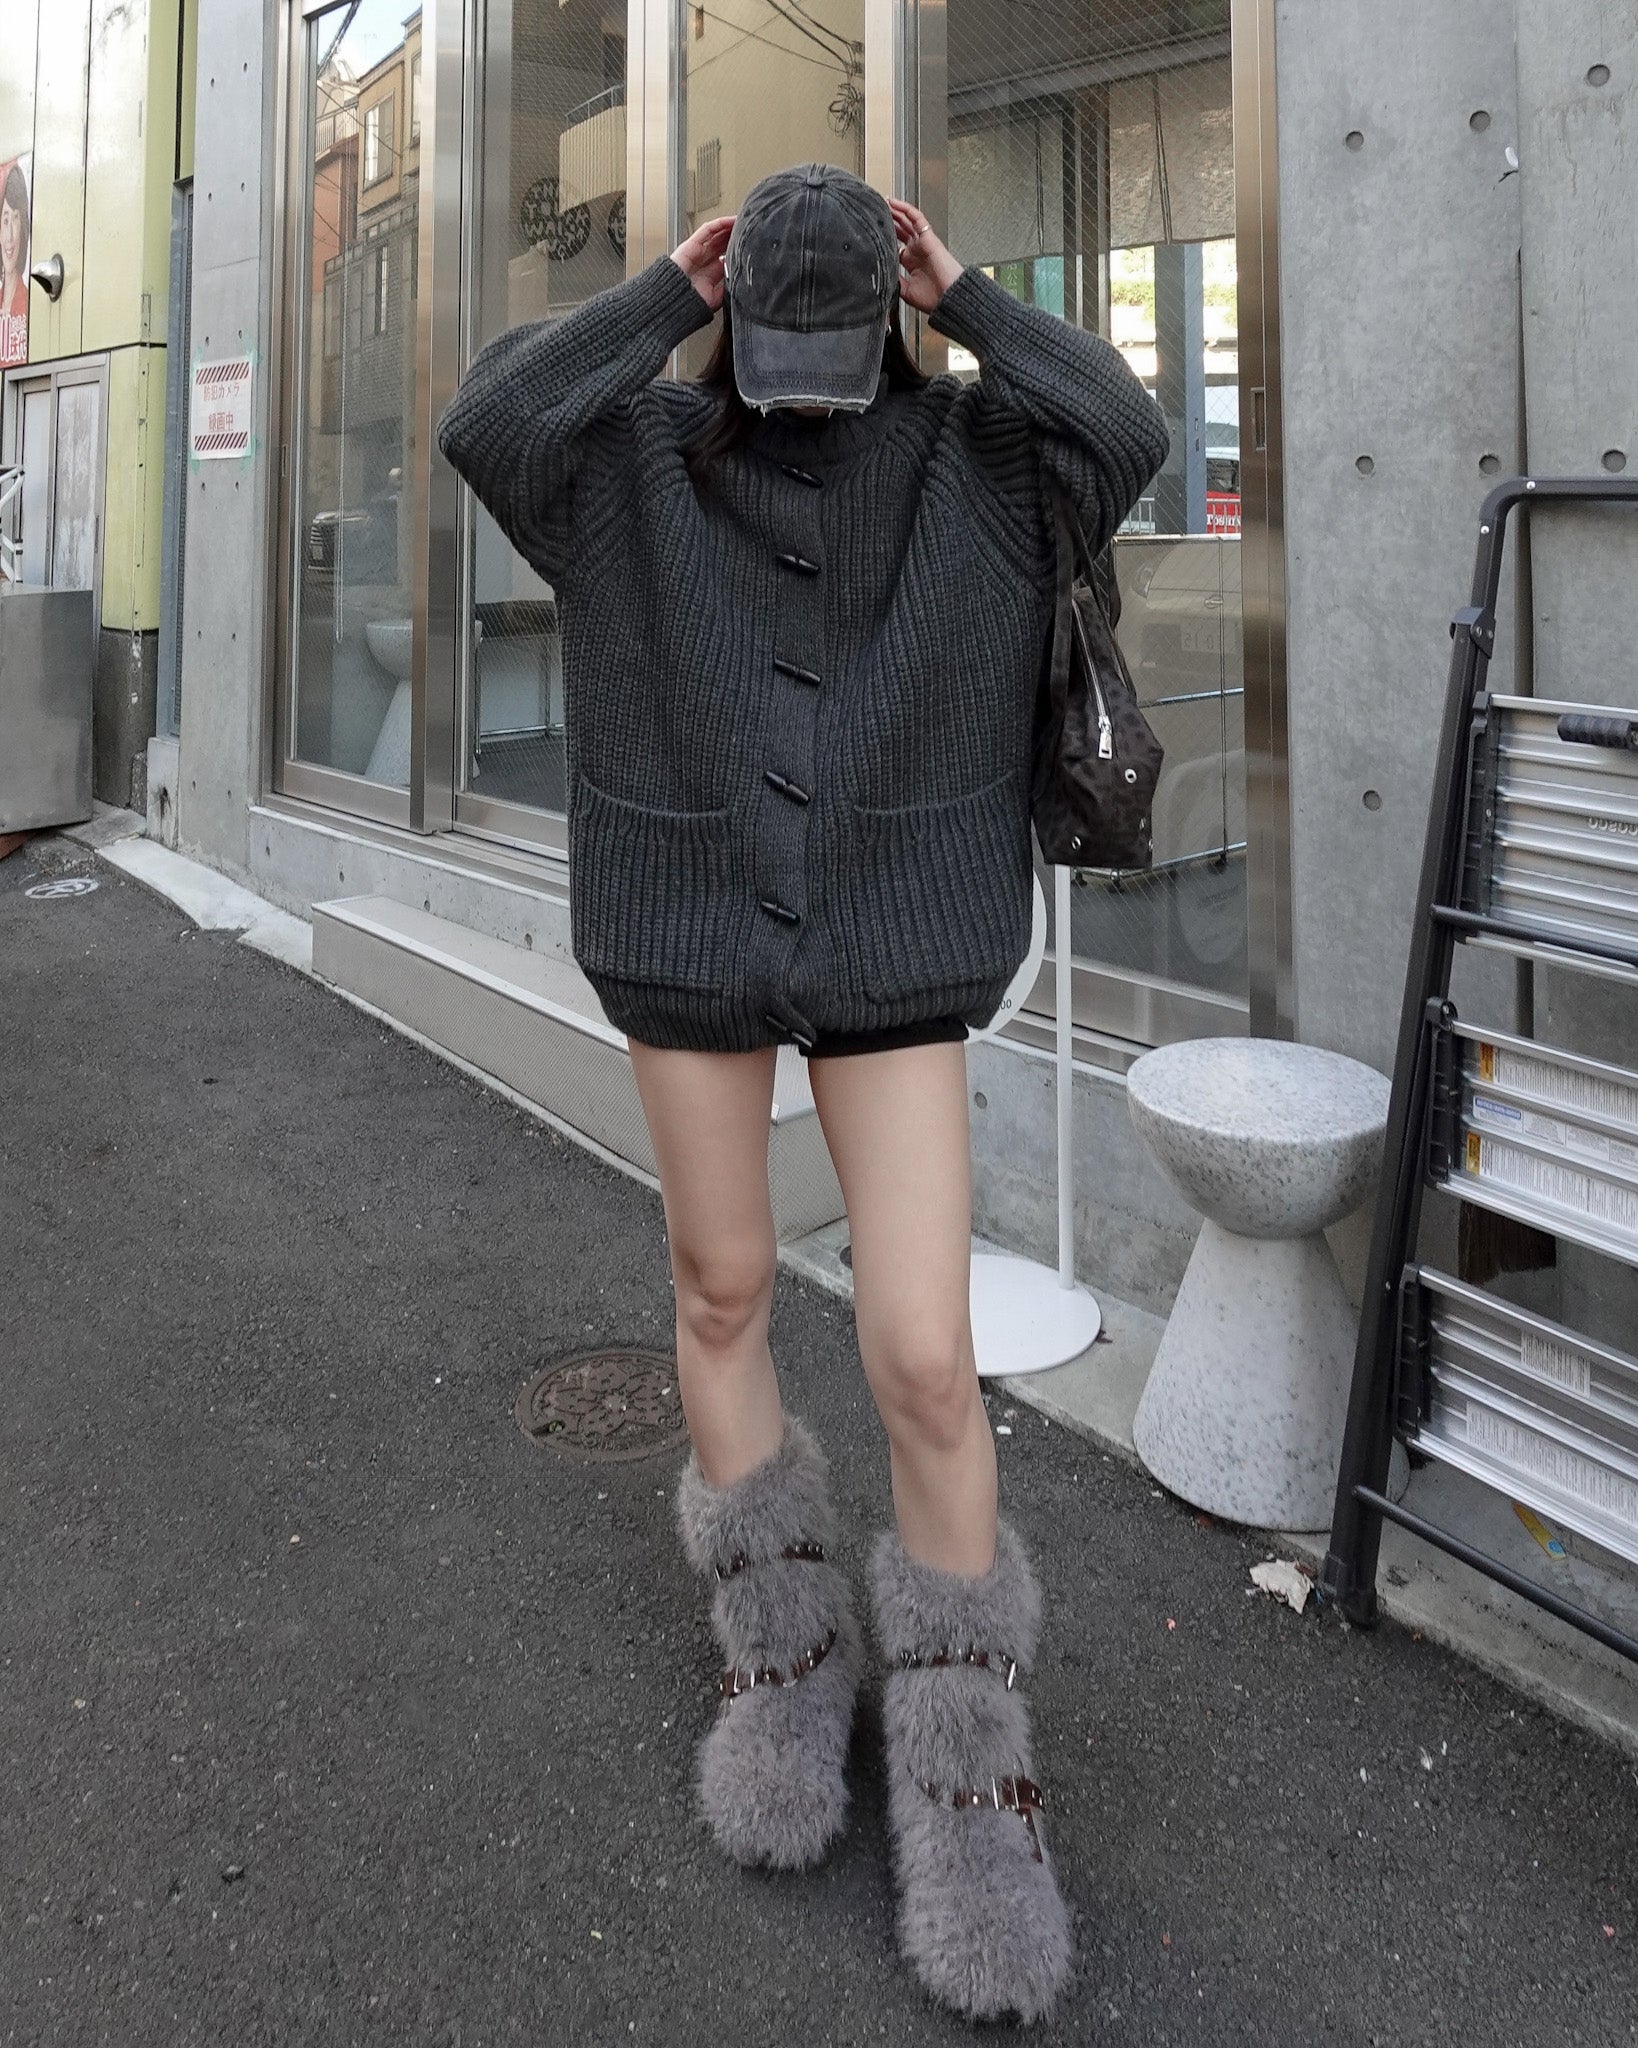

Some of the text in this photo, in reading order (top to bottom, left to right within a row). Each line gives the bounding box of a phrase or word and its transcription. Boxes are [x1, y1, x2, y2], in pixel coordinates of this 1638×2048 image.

[203, 383, 240, 402] 防犯カメラ
[208, 411, 234, 432] 録画中
[1000, 998, 1012, 1010] 00
